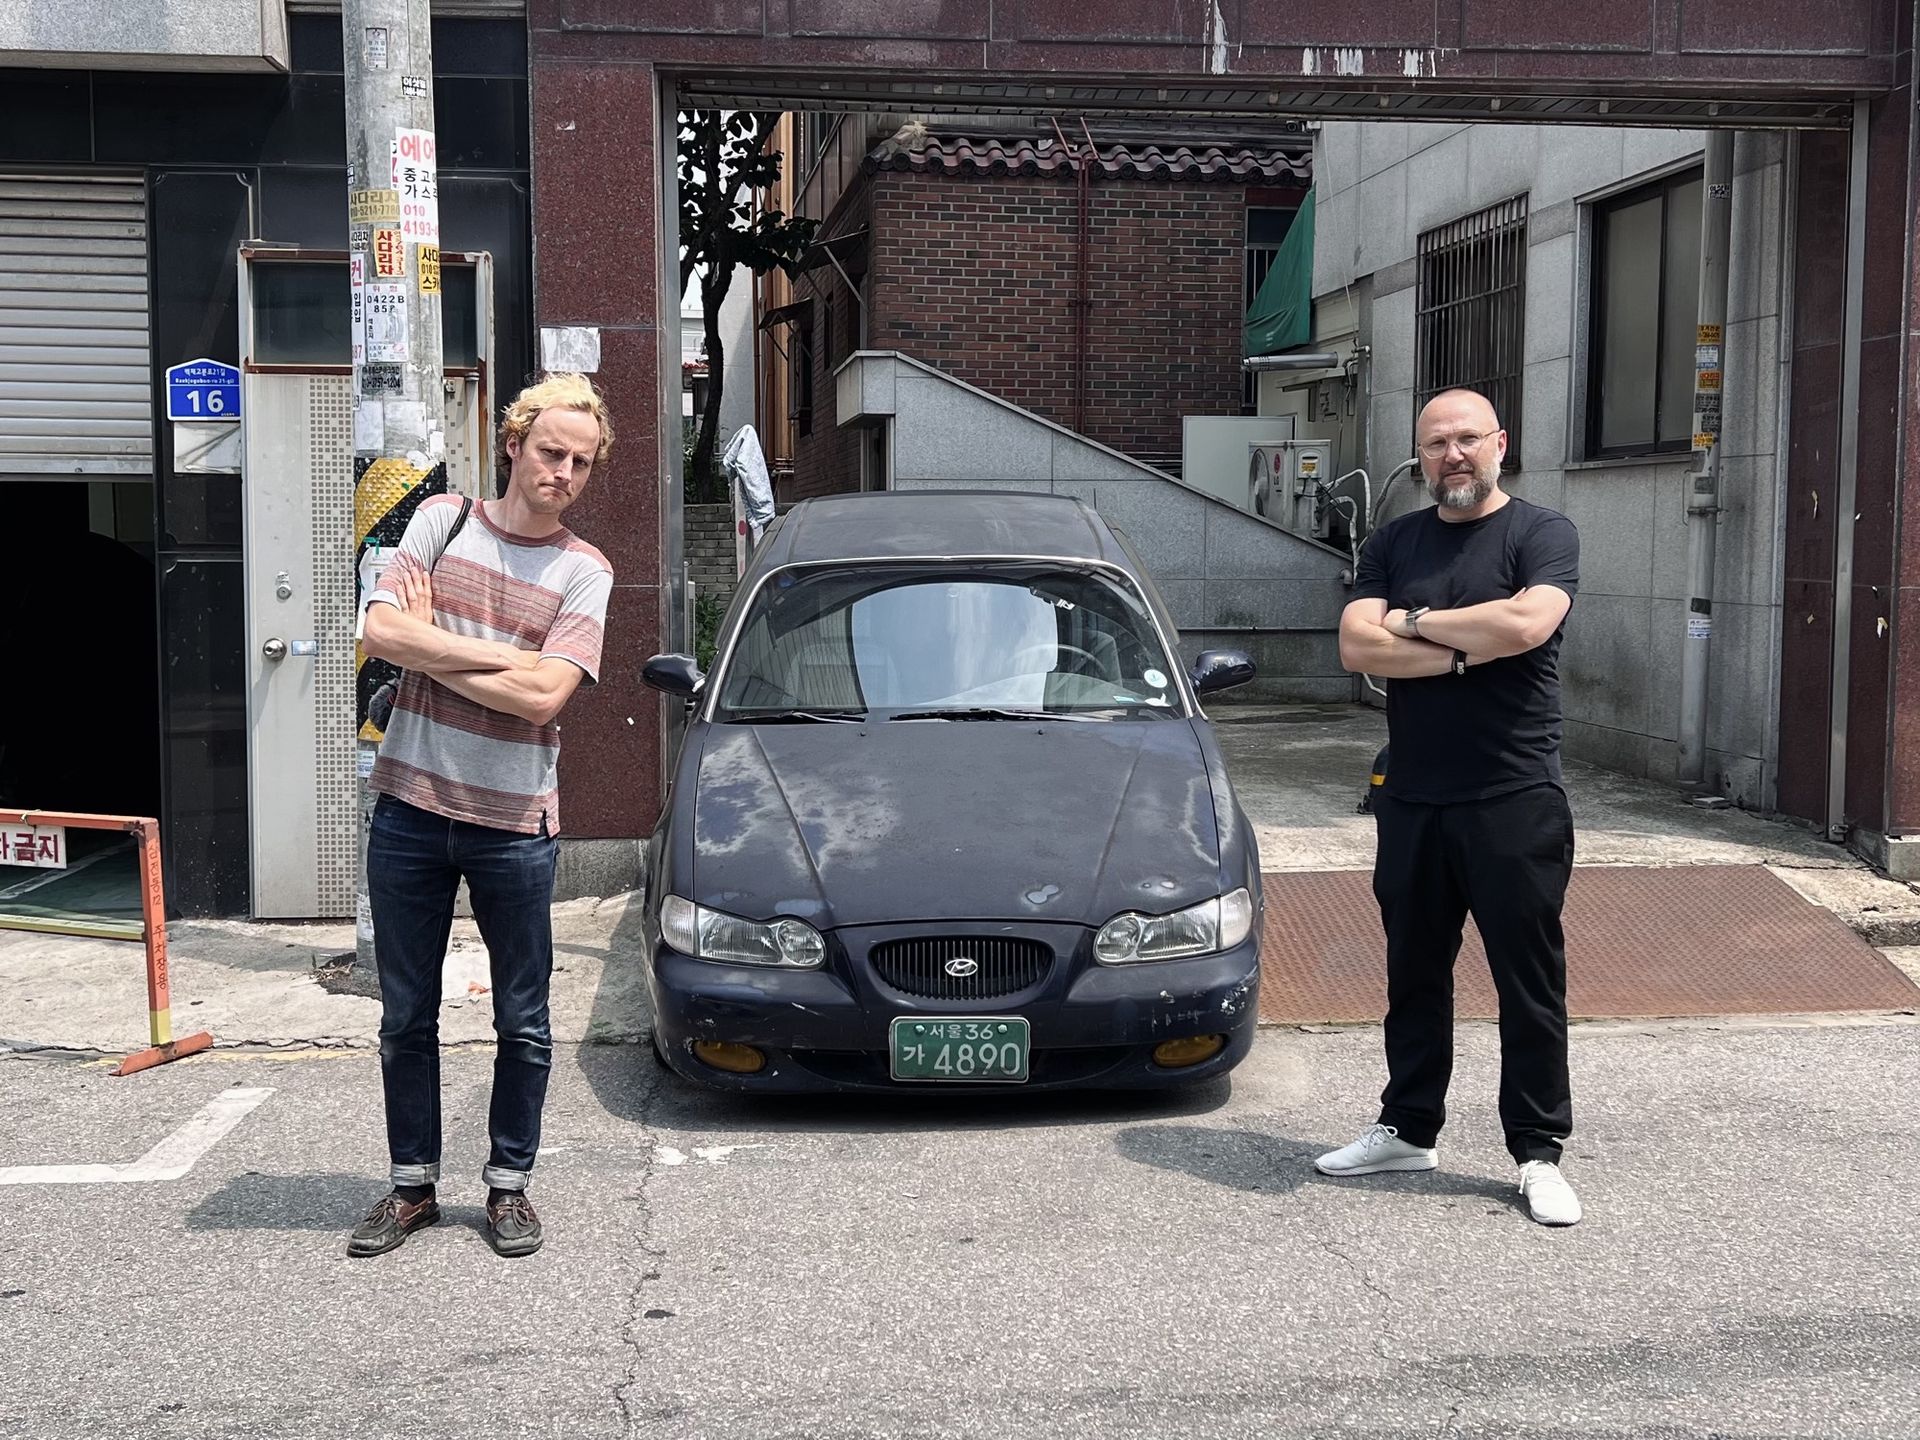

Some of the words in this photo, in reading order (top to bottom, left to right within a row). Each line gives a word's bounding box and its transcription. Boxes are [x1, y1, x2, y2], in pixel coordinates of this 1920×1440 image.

[403, 204, 425, 216] 010
[187, 390, 224, 413] 16
[903, 1043, 925, 1065] 가
[933, 1042, 1021, 1075] 4890
